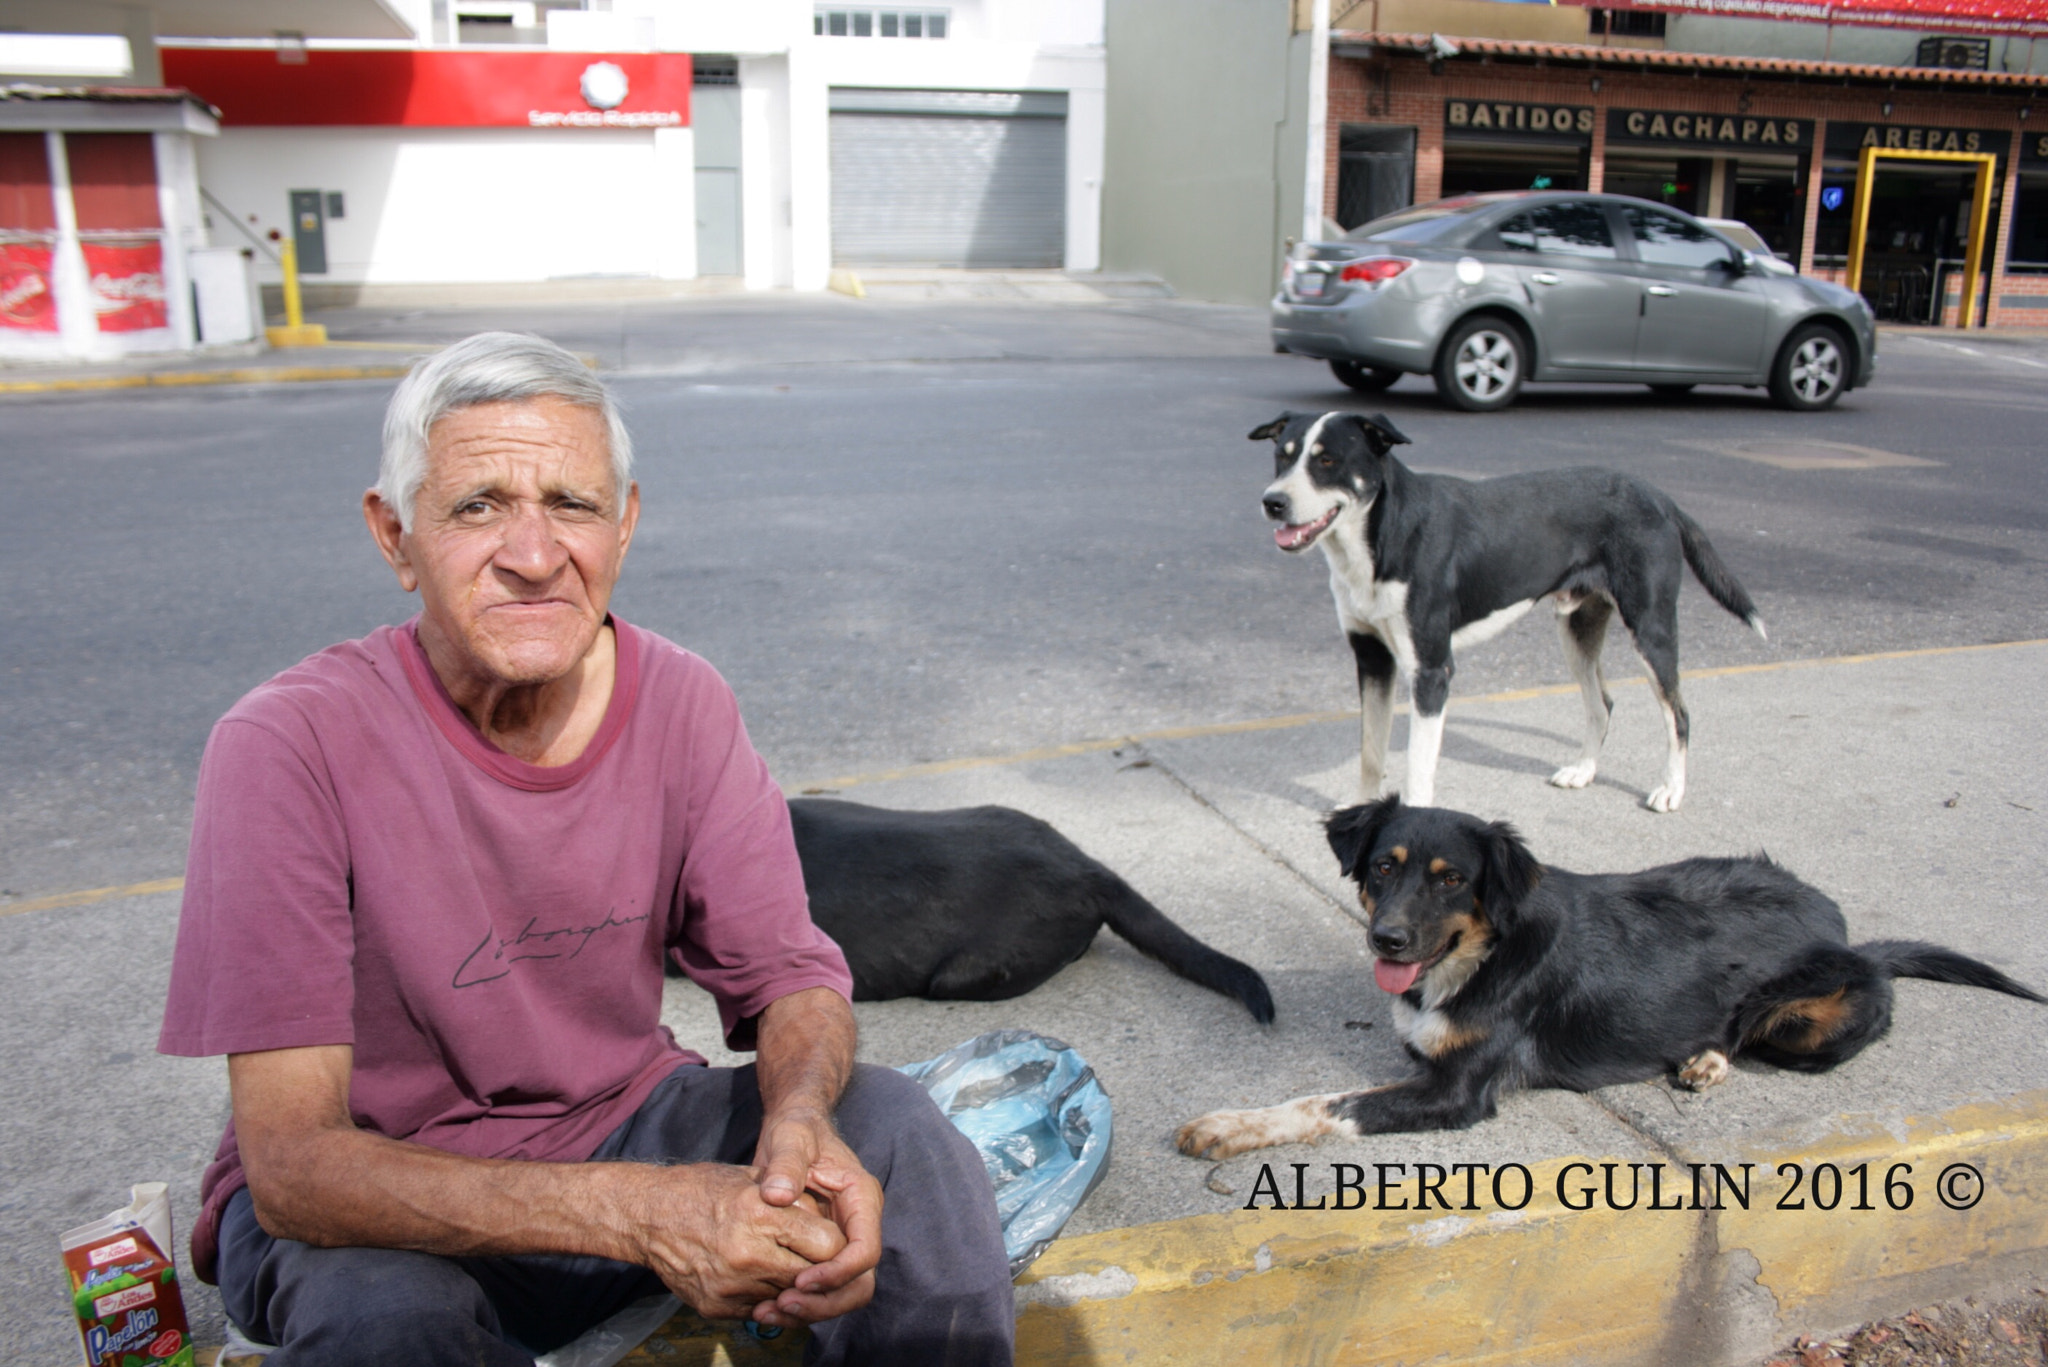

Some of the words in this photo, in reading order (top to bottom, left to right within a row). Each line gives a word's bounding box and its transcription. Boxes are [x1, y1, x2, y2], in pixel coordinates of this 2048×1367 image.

[1714, 0, 1762, 13] CONSUMO
[1763, 1, 1831, 19] RESPONSABLE
[1449, 101, 1595, 132] BATIDOS
[1627, 112, 1800, 143] CACHAPAS
[1862, 126, 1981, 151] AREPAS
[117, 1291, 154, 1309] Andes
[88, 1307, 159, 1365] Papelón
